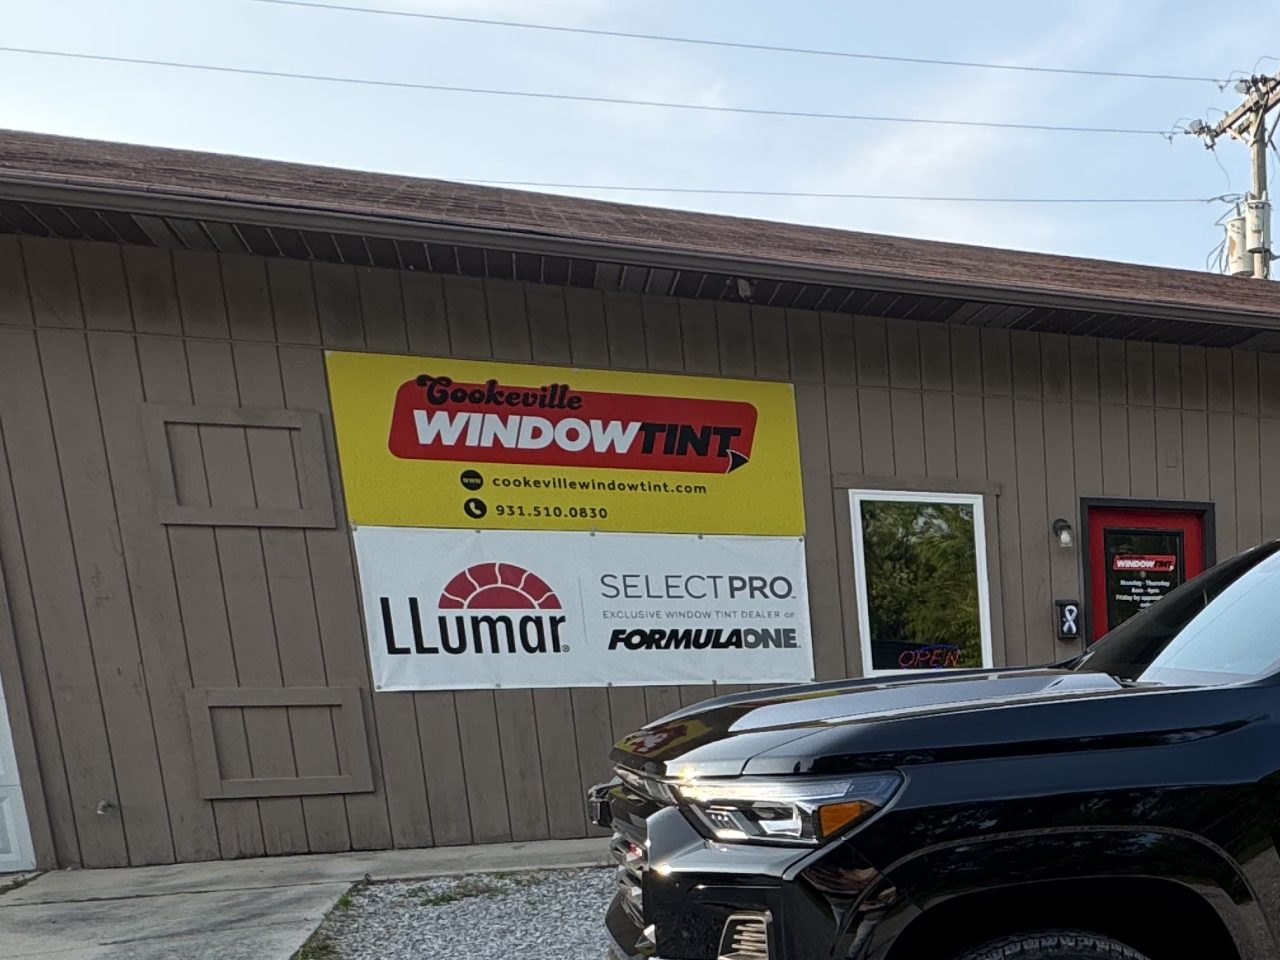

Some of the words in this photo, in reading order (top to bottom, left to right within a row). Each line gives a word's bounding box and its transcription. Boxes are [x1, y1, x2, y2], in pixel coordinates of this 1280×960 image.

[416, 374, 583, 411] Cookeville
[492, 476, 707, 494] cookevillewindowtint.com
[495, 504, 609, 520] 931.510.0830
[602, 610, 662, 619] EXCLUSIVE
[665, 611, 711, 619] WINDOW
[714, 610, 738, 619] TINT
[741, 610, 780, 618] DEALER
[899, 649, 961, 668] OPEN
